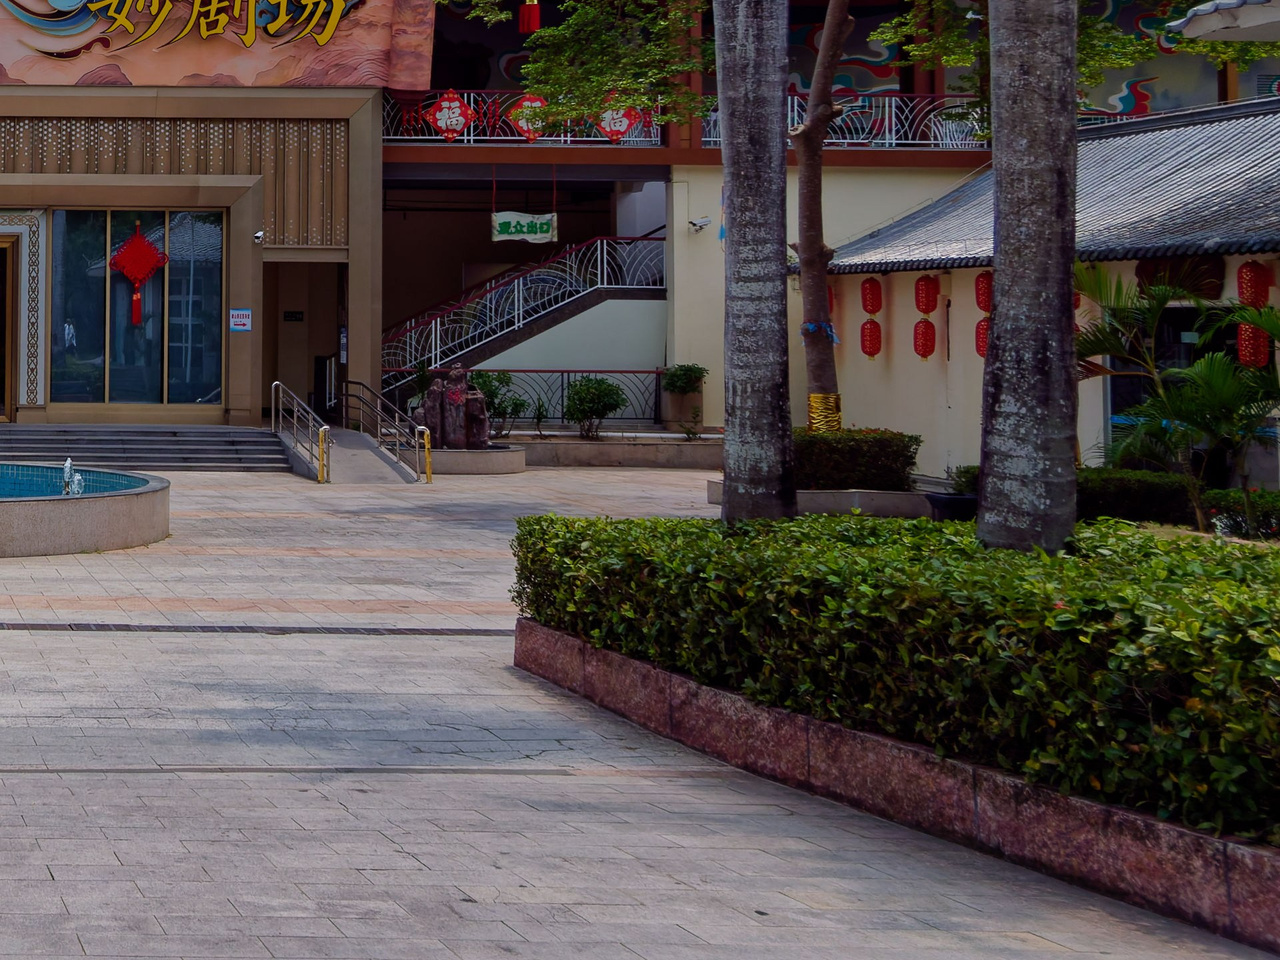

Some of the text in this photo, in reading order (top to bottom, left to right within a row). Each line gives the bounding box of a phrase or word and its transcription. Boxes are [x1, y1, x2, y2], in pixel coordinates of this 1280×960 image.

[435, 101, 466, 132] 福
[496, 220, 552, 235] 观众出口
